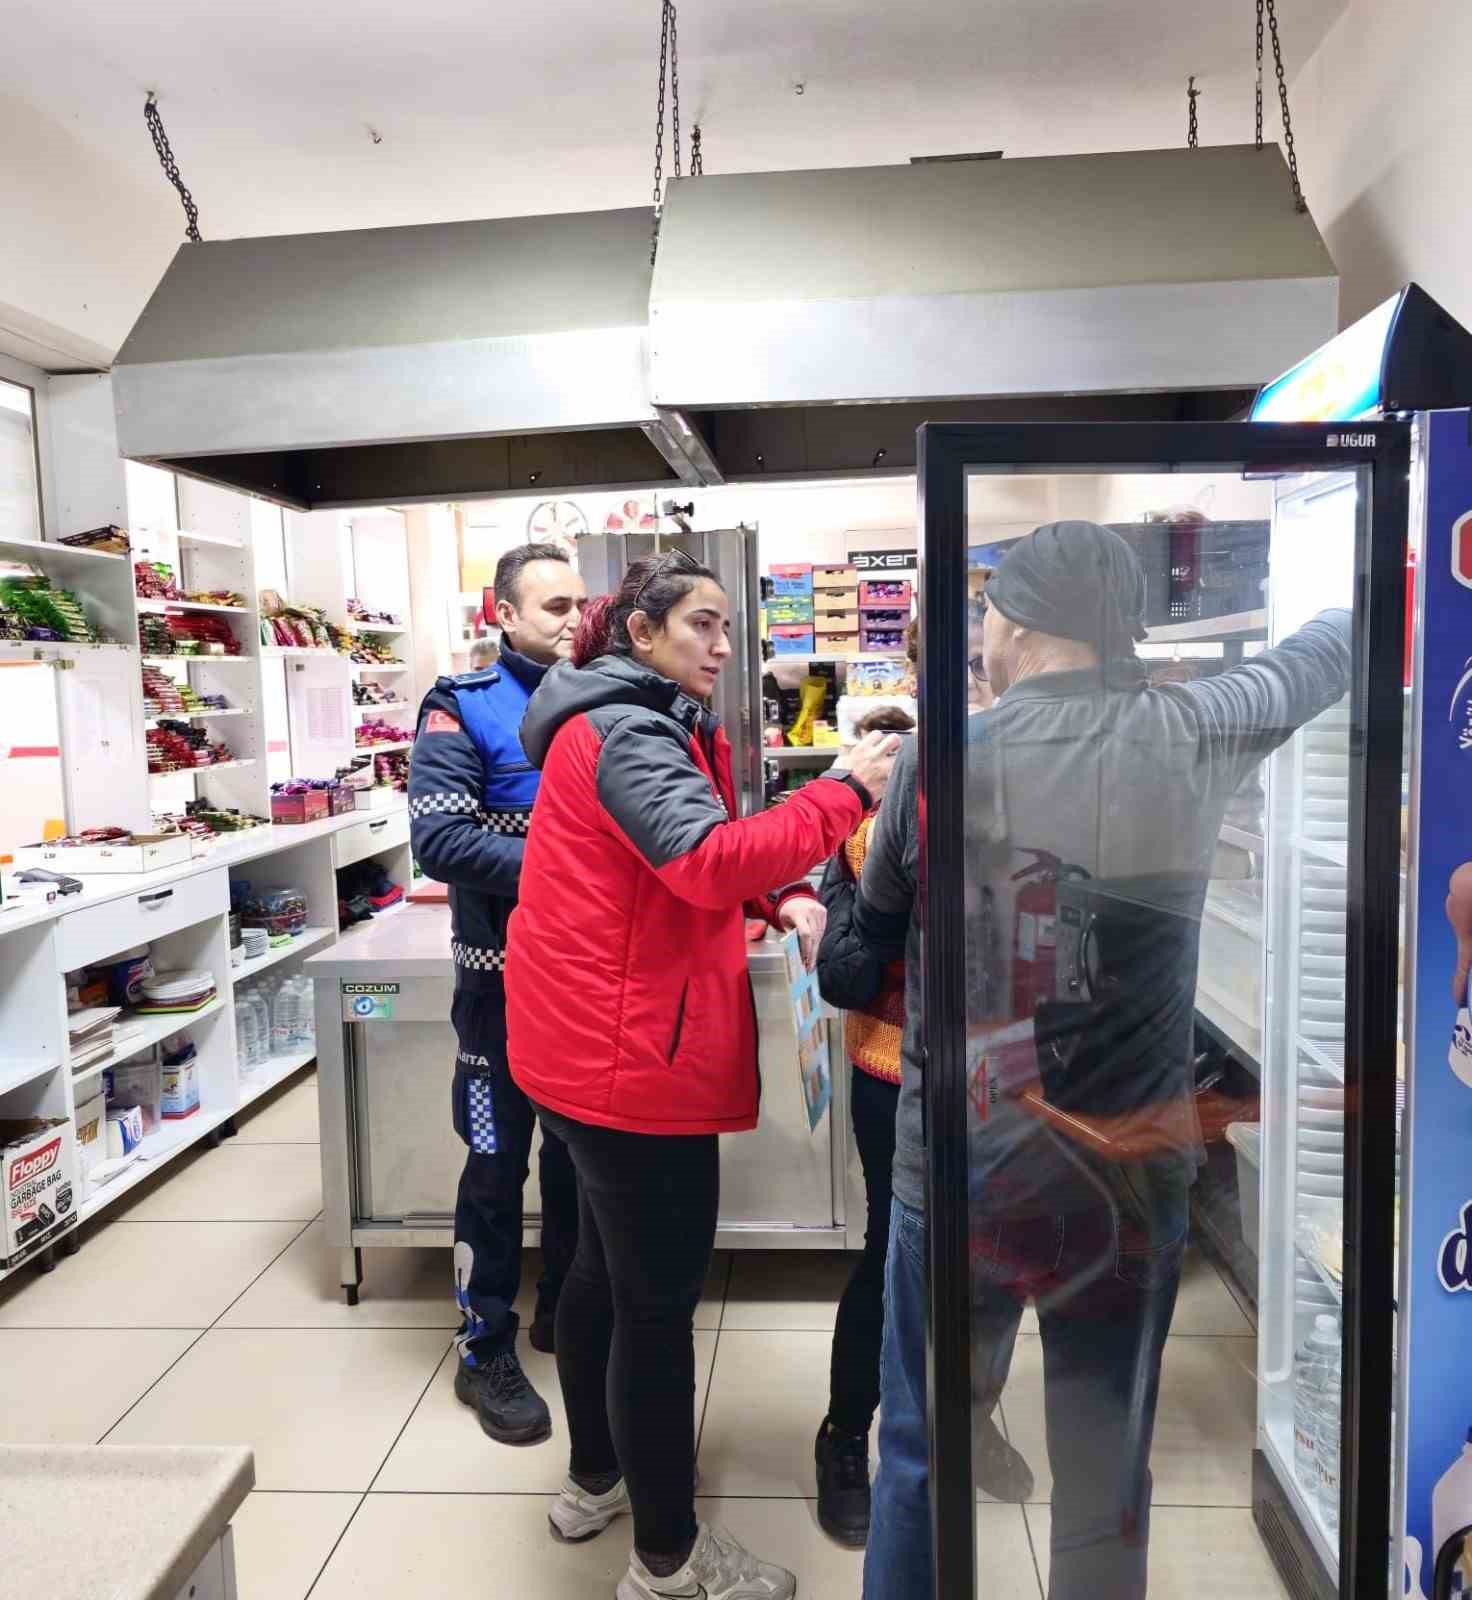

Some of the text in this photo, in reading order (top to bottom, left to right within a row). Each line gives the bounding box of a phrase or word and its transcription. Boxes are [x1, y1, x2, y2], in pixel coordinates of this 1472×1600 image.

[11, 1144, 60, 1183] Floppy
[10, 1179, 46, 1209] GARBAGE
[46, 1169, 62, 1187] BAG
